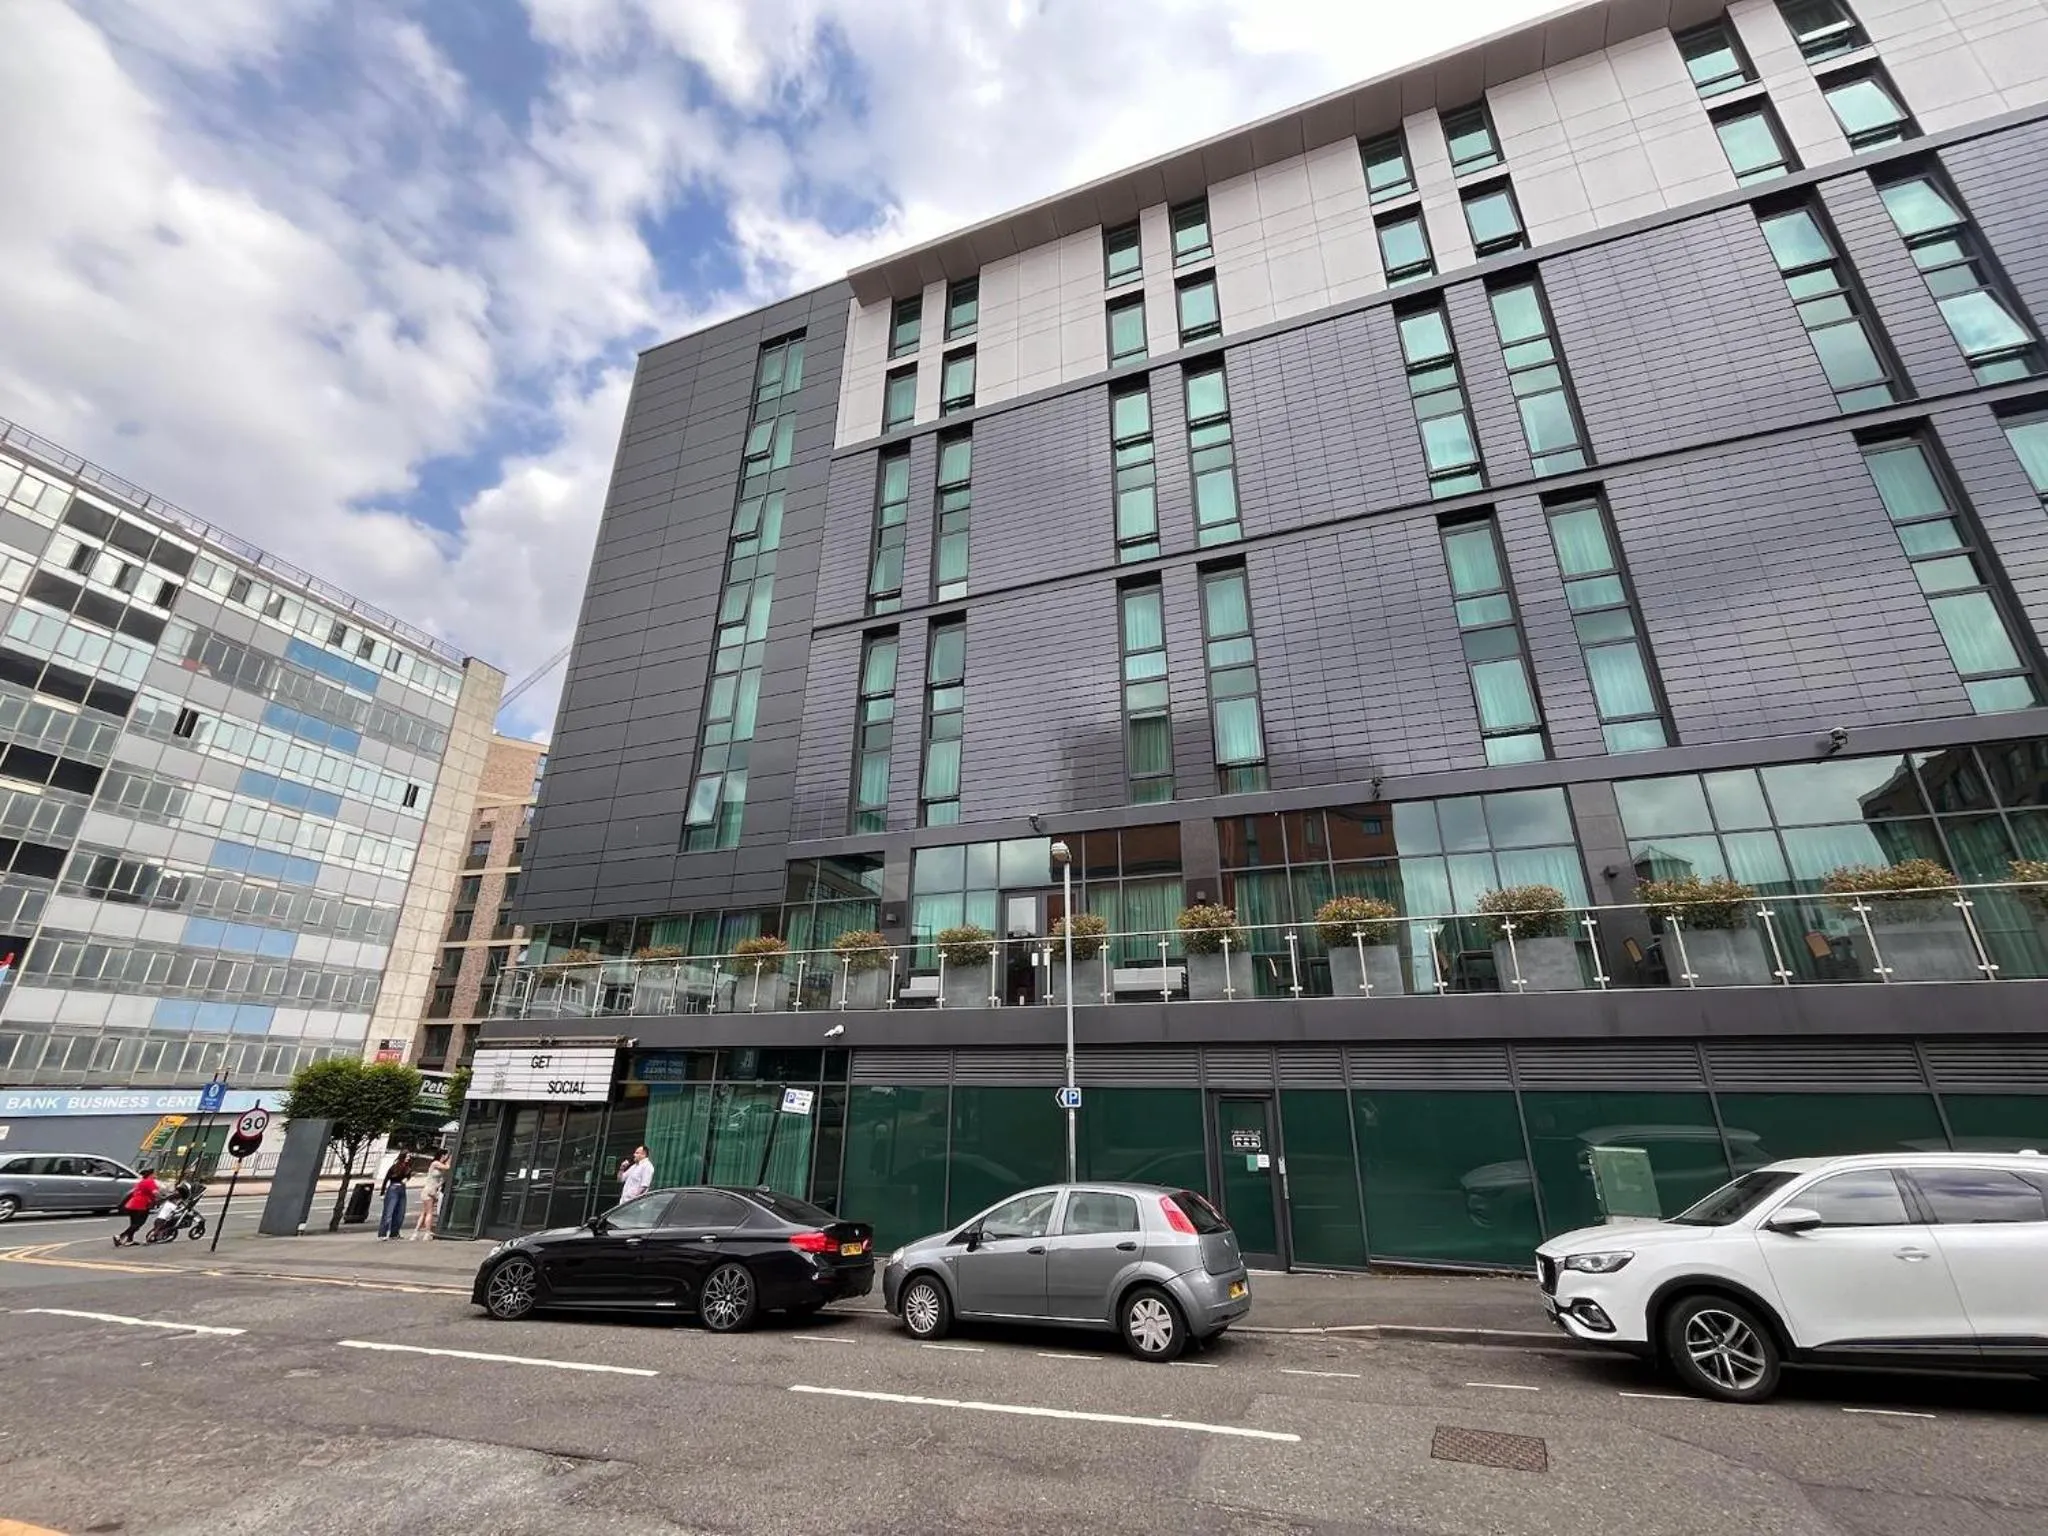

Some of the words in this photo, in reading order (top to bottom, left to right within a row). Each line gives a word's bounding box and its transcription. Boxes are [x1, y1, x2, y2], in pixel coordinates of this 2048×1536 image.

[531, 1056, 552, 1069] GET
[420, 1080, 450, 1095] Pete
[547, 1081, 586, 1095] SOCIAL
[6, 1097, 60, 1110] BANK
[67, 1096, 149, 1109] BUSINESS
[156, 1095, 201, 1108] CENT
[241, 1117, 266, 1131] 30
